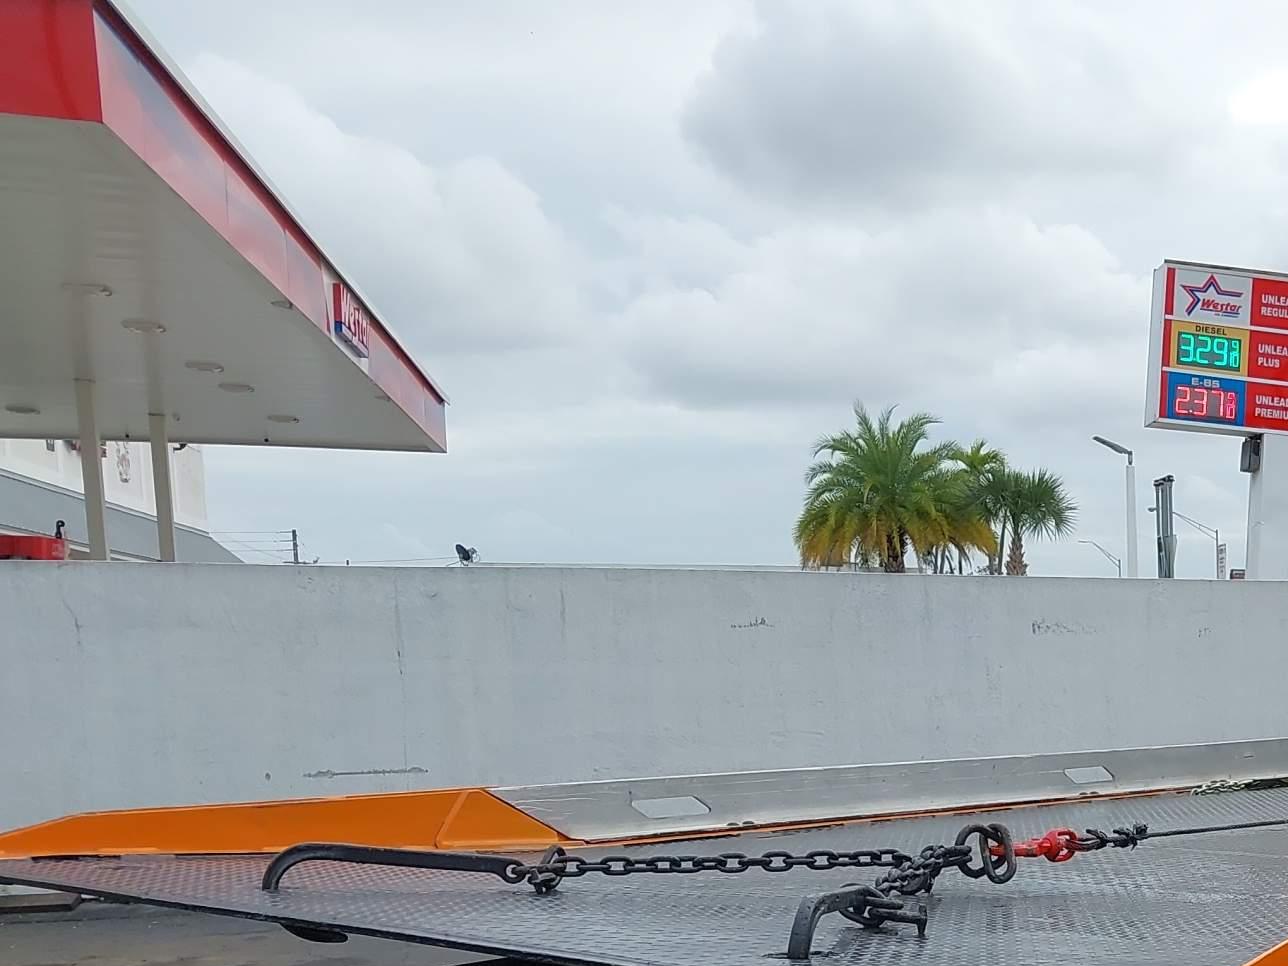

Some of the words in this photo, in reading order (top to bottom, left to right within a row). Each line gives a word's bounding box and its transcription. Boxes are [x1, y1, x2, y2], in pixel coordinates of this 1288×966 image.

[1200, 298, 1242, 313] Westar
[1195, 325, 1228, 336] DIESEL
[1257, 357, 1281, 369] PLUS
[1191, 377, 1220, 388] E-85
[1175, 386, 1225, 417] 2.37
